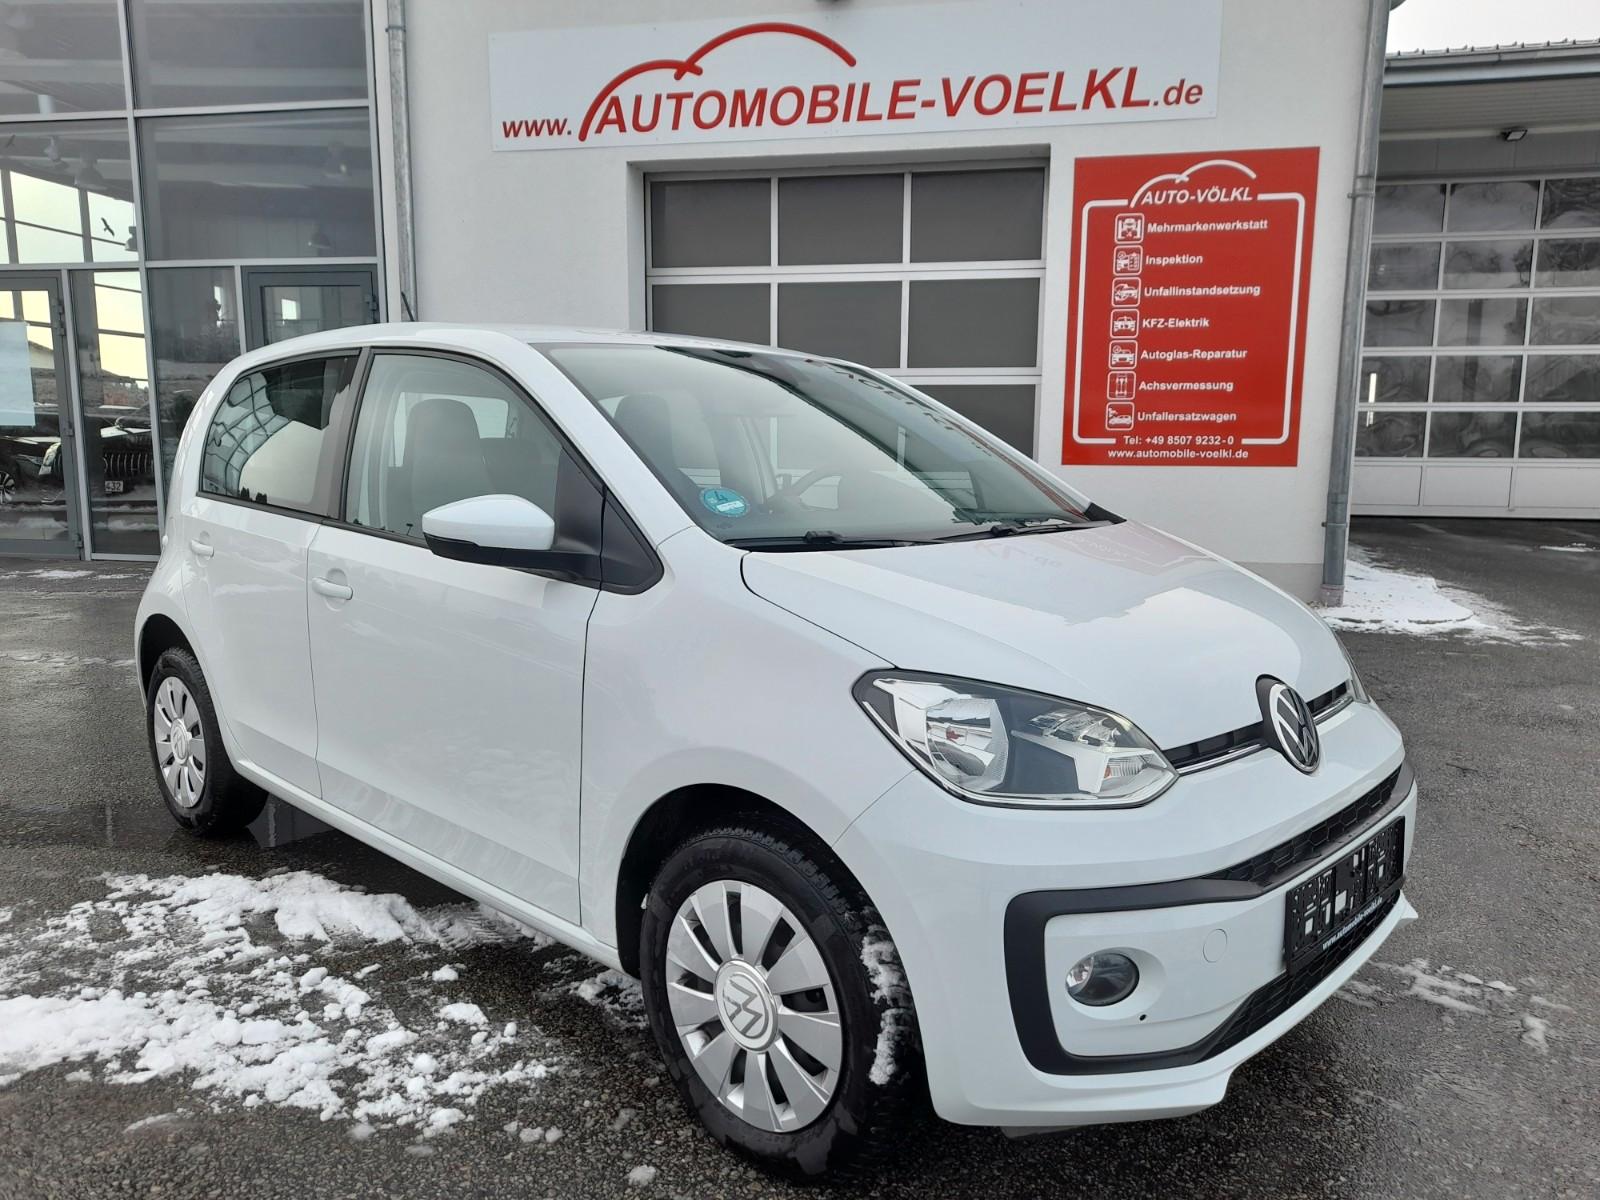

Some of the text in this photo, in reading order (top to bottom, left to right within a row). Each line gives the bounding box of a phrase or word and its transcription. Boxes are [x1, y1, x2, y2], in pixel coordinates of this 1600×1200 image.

[1140, 186, 1253, 205] AUTO-VÖLKL
[1147, 219, 1268, 233] Mehrmarkenwerkstatt
[1145, 253, 1204, 267] Inspektion
[1143, 284, 1261, 298] Unfallinstandsetzung
[1141, 317, 1210, 329] KFZ-Elektrik
[1140, 348, 1248, 361] Autoglas-Reparatur
[1138, 380, 1234, 392] Achsvermessung
[1137, 410, 1237, 423] Unfallersatzwagen
[1123, 435, 1142, 445] Tel:
[1145, 435, 1164, 445] +49
[1167, 435, 1192, 445] 8507
[1107, 447, 1249, 459] www.automobile-voelkl.de
